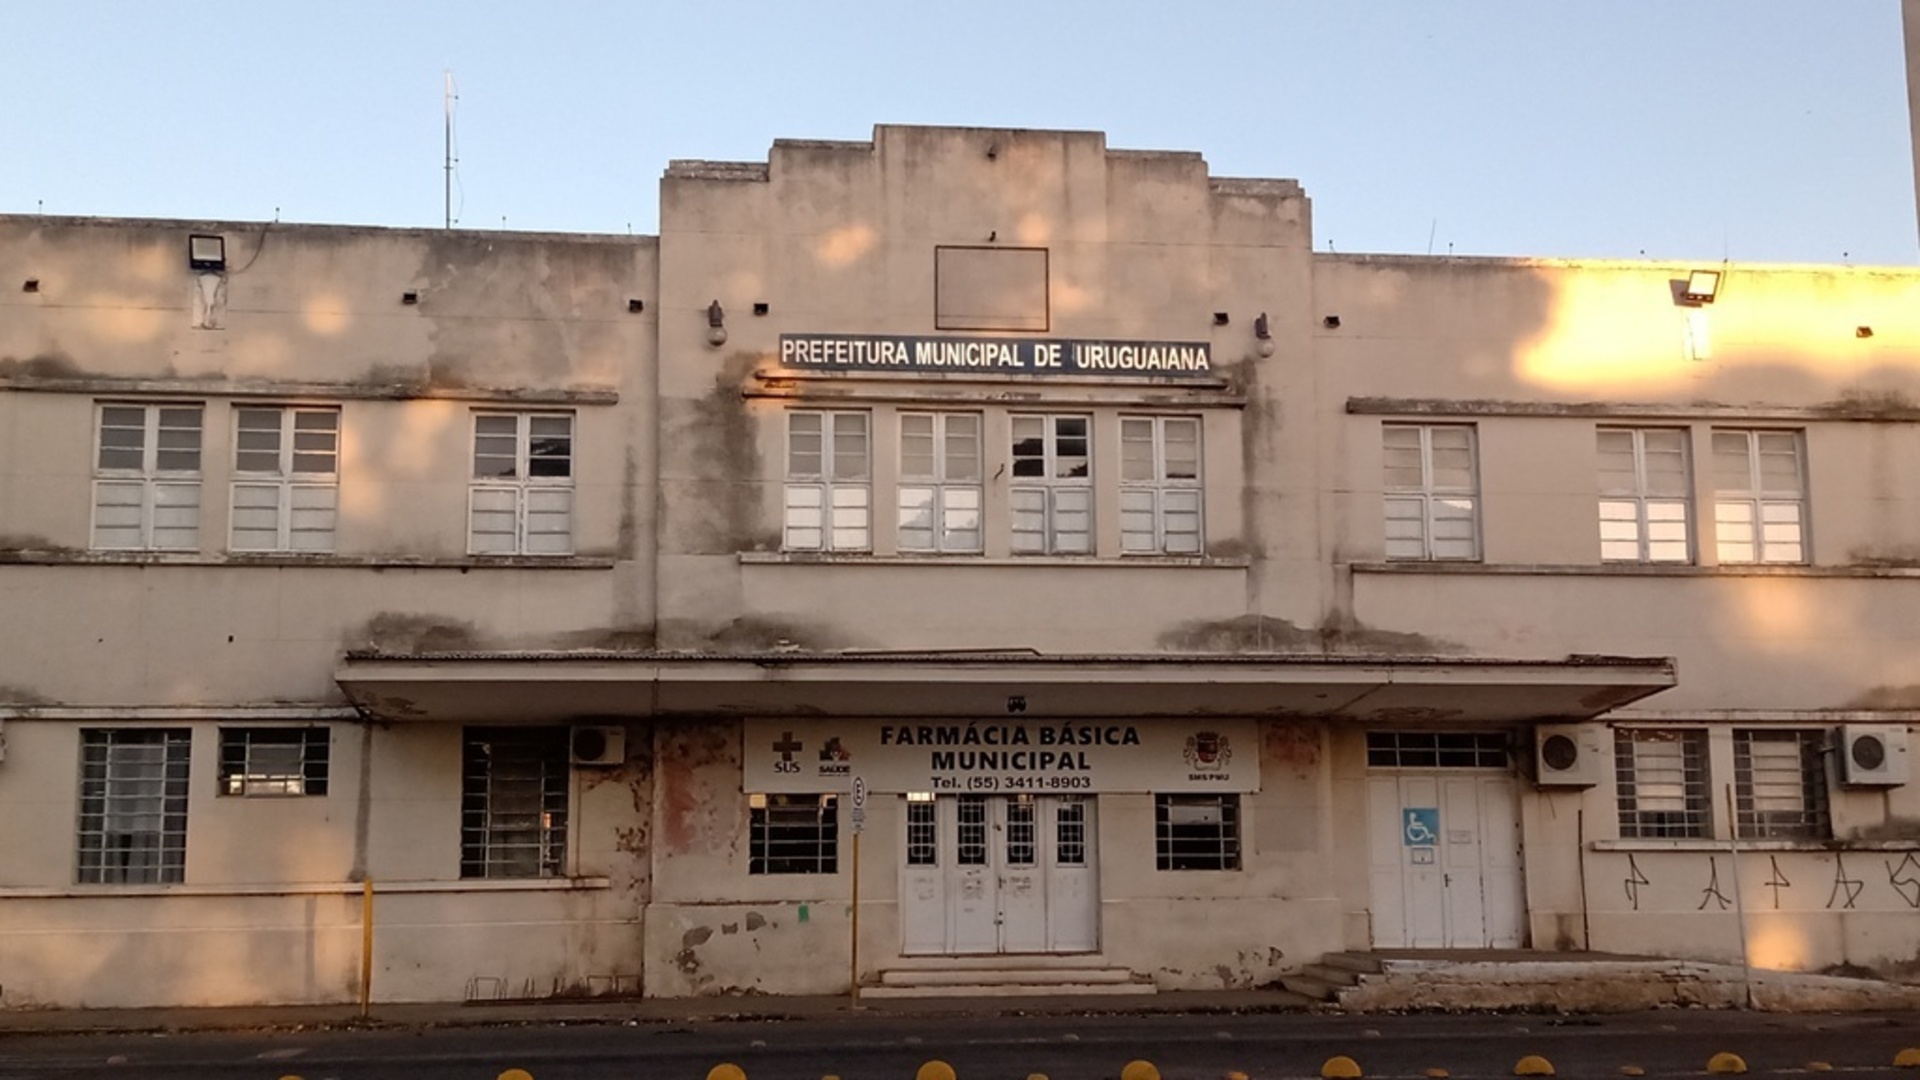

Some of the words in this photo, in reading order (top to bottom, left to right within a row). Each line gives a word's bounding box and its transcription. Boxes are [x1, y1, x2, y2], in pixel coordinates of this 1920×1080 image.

[781, 340, 910, 365] PREFEITURA
[915, 342, 1025, 367] MUNICIPAL
[1034, 344, 1062, 367] DE
[1076, 345, 1210, 370] URUGUAIANA
[880, 722, 1030, 746] FARMÁCIA
[1039, 722, 1141, 746] BÁSICA
[774, 761, 801, 774] SUS
[930, 751, 1092, 771] MUNICIPAL
[931, 776, 962, 790] Tel.
[967, 776, 1000, 791] (55)
[1004, 776, 1092, 790] 3411-8903
